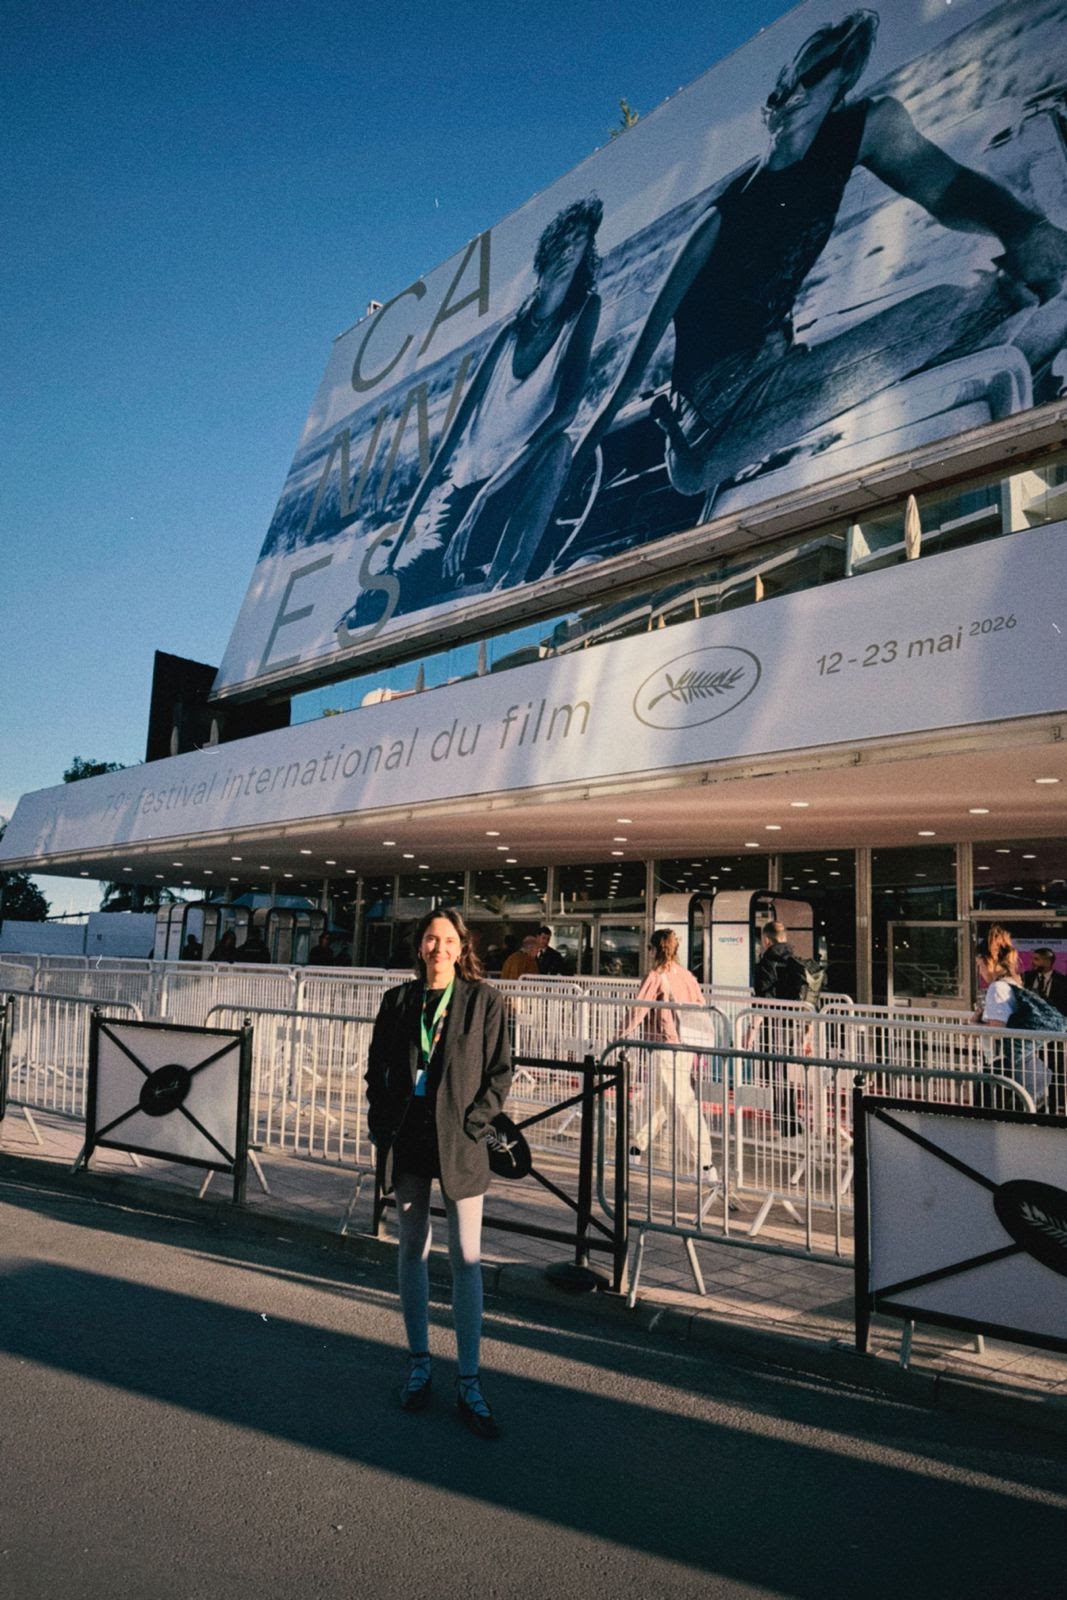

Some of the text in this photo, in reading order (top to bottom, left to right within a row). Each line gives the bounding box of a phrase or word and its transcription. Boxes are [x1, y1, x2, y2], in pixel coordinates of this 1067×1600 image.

[907, 626, 963, 658] mai
[969, 613, 1018, 636] 2026
[133, 771, 218, 815] festival
[221, 727, 419, 800] international
[430, 718, 481, 762] du
[500, 698, 591, 749] film
